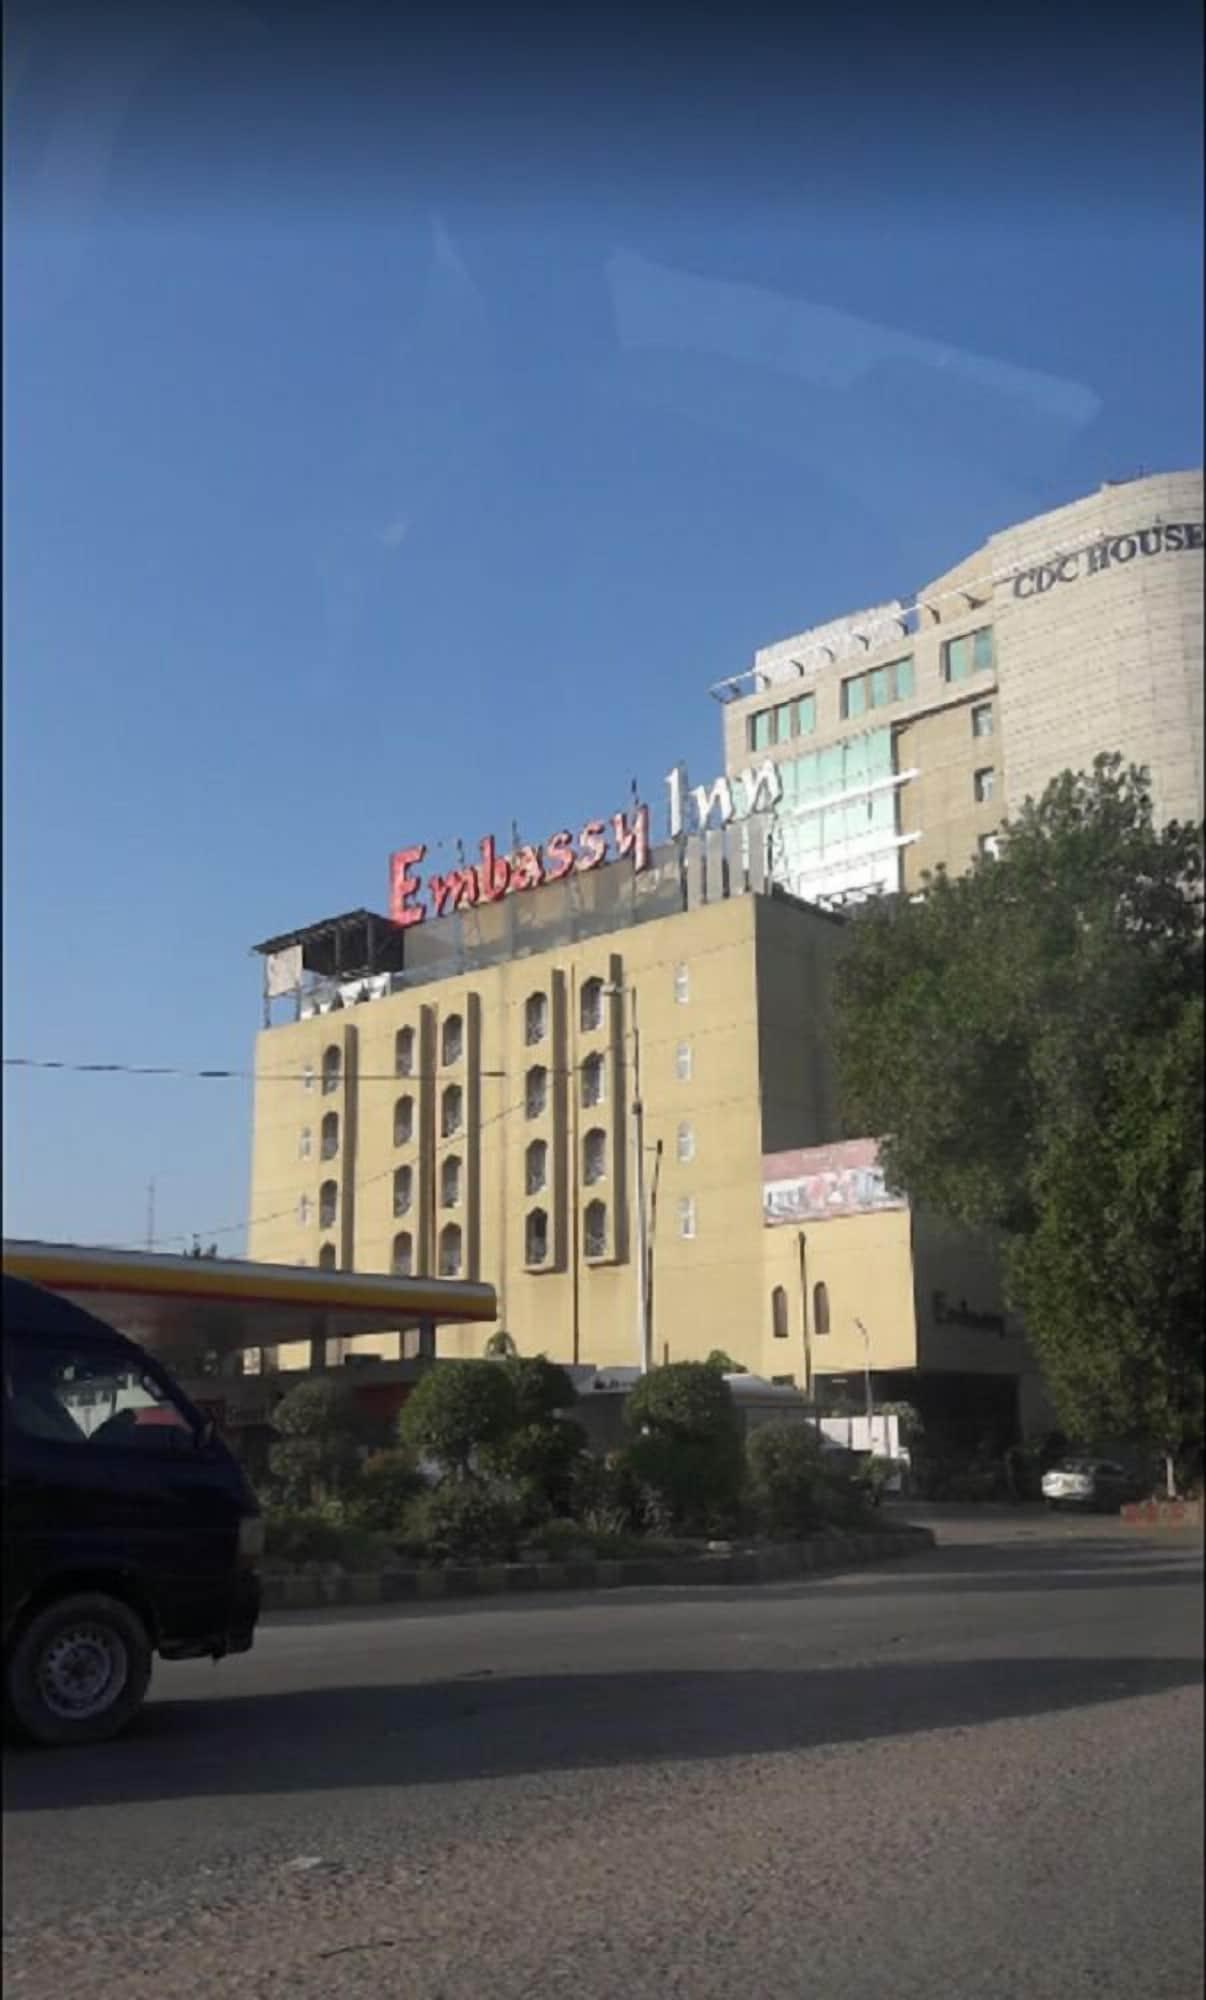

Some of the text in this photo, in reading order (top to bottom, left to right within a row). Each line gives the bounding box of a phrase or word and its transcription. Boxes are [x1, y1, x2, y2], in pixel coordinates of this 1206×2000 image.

[1013, 523, 1204, 598] CDC HOUSE
[389, 759, 782, 927] Embassy Inn
